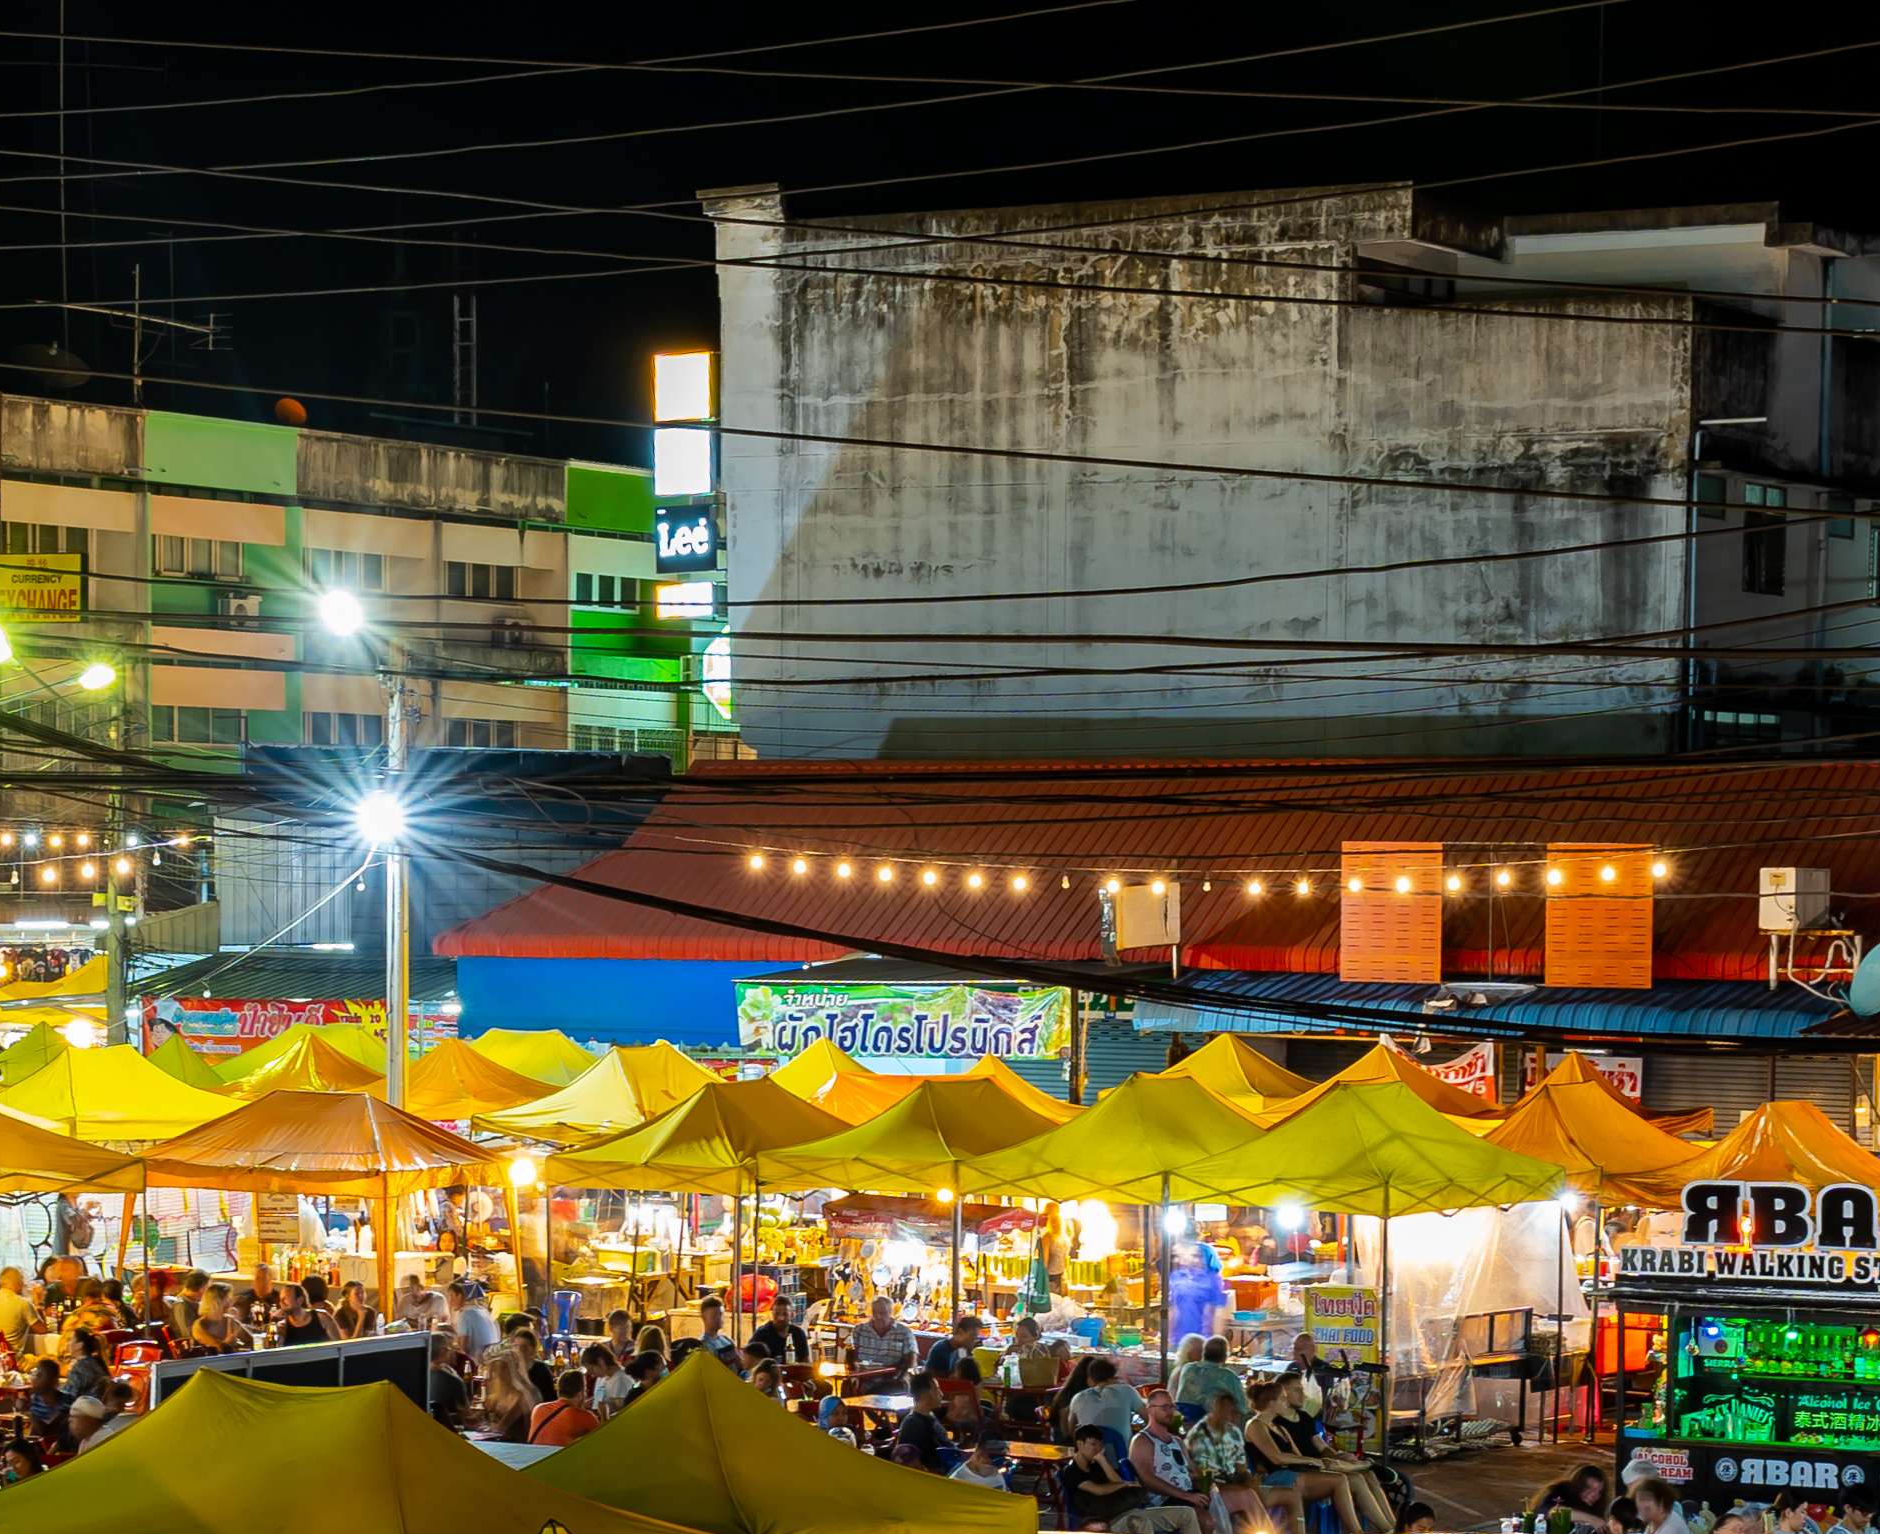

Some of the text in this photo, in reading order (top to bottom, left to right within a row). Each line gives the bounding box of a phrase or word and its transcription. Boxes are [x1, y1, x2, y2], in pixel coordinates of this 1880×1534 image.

[657, 516, 710, 558] Lee
[10, 574, 62, 585] CURRENCY
[781, 987, 849, 1008] จำหน่าย
[1621, 1248, 1705, 1276] KRABI
[1714, 1252, 1845, 1281] WALKING
[1343, 1328, 1374, 1344] FOOD
[1797, 1394, 1848, 1410] Alcohol
